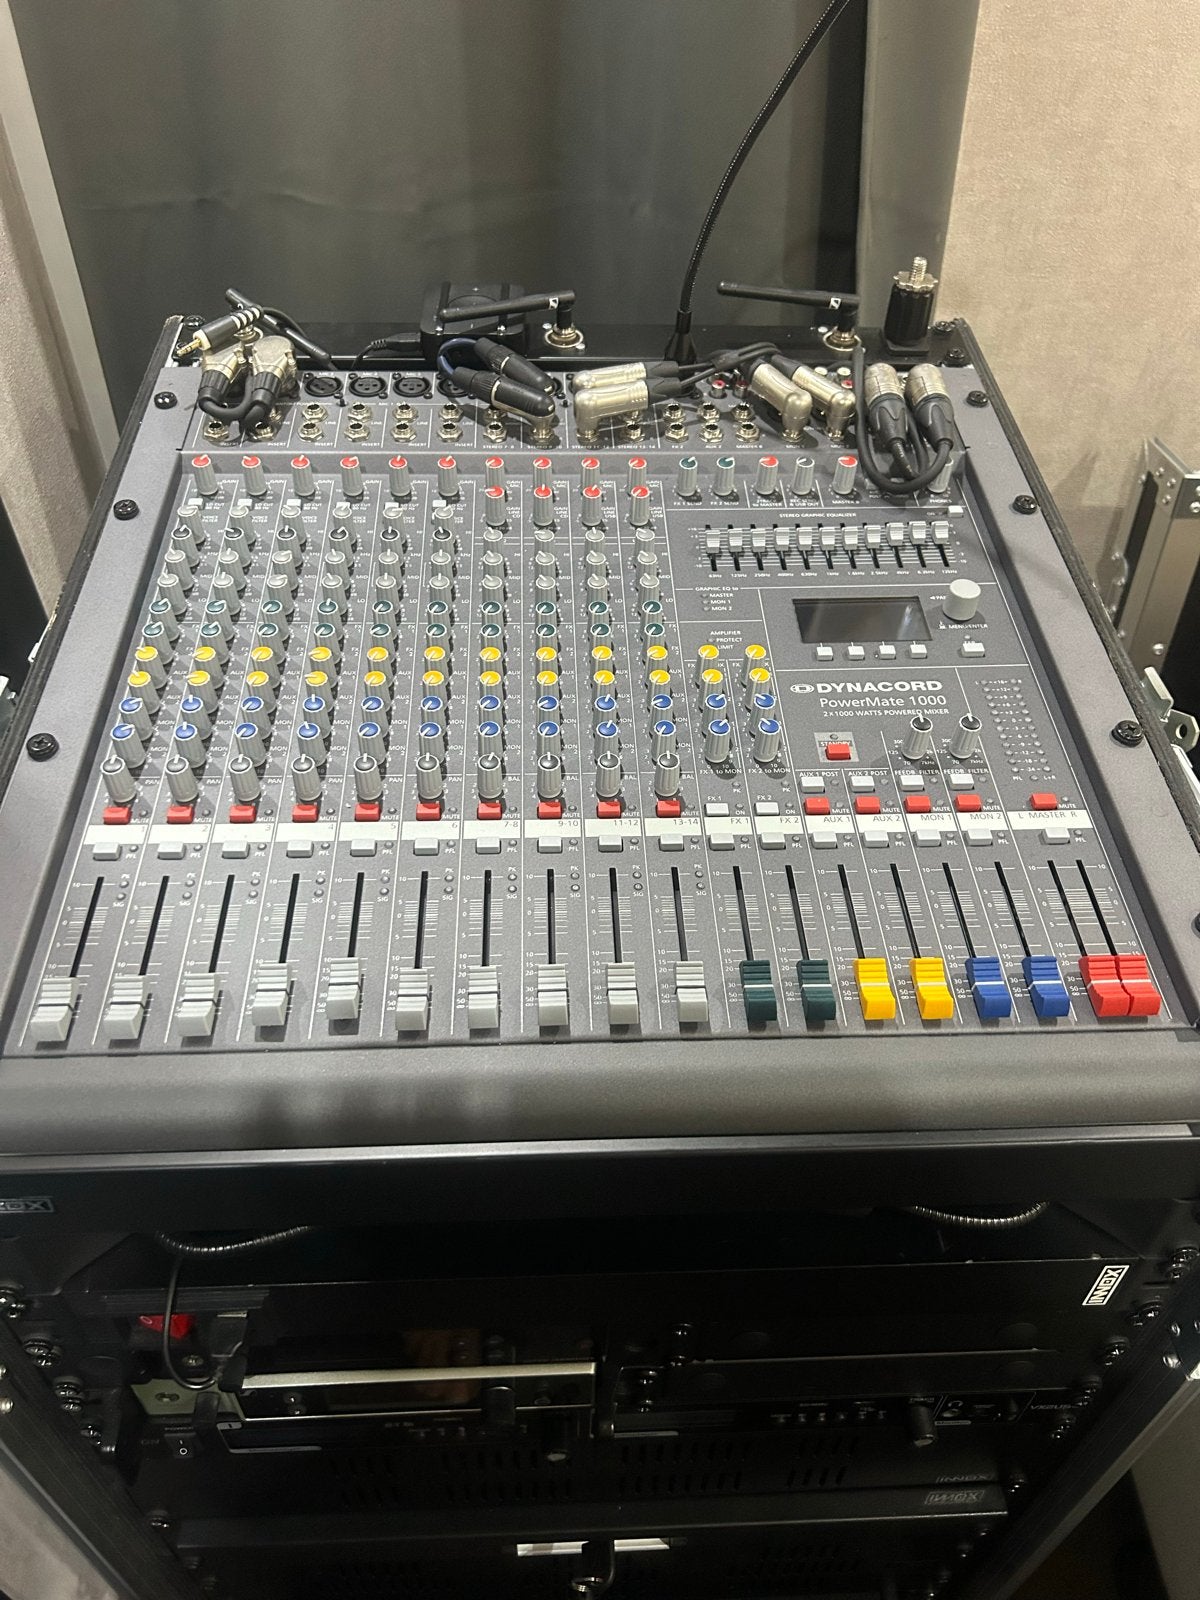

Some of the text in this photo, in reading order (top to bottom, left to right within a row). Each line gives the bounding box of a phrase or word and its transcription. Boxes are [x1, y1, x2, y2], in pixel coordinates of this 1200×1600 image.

[816, 681, 942, 693] DYNACORD
[819, 695, 947, 707] PowerMate 1000
